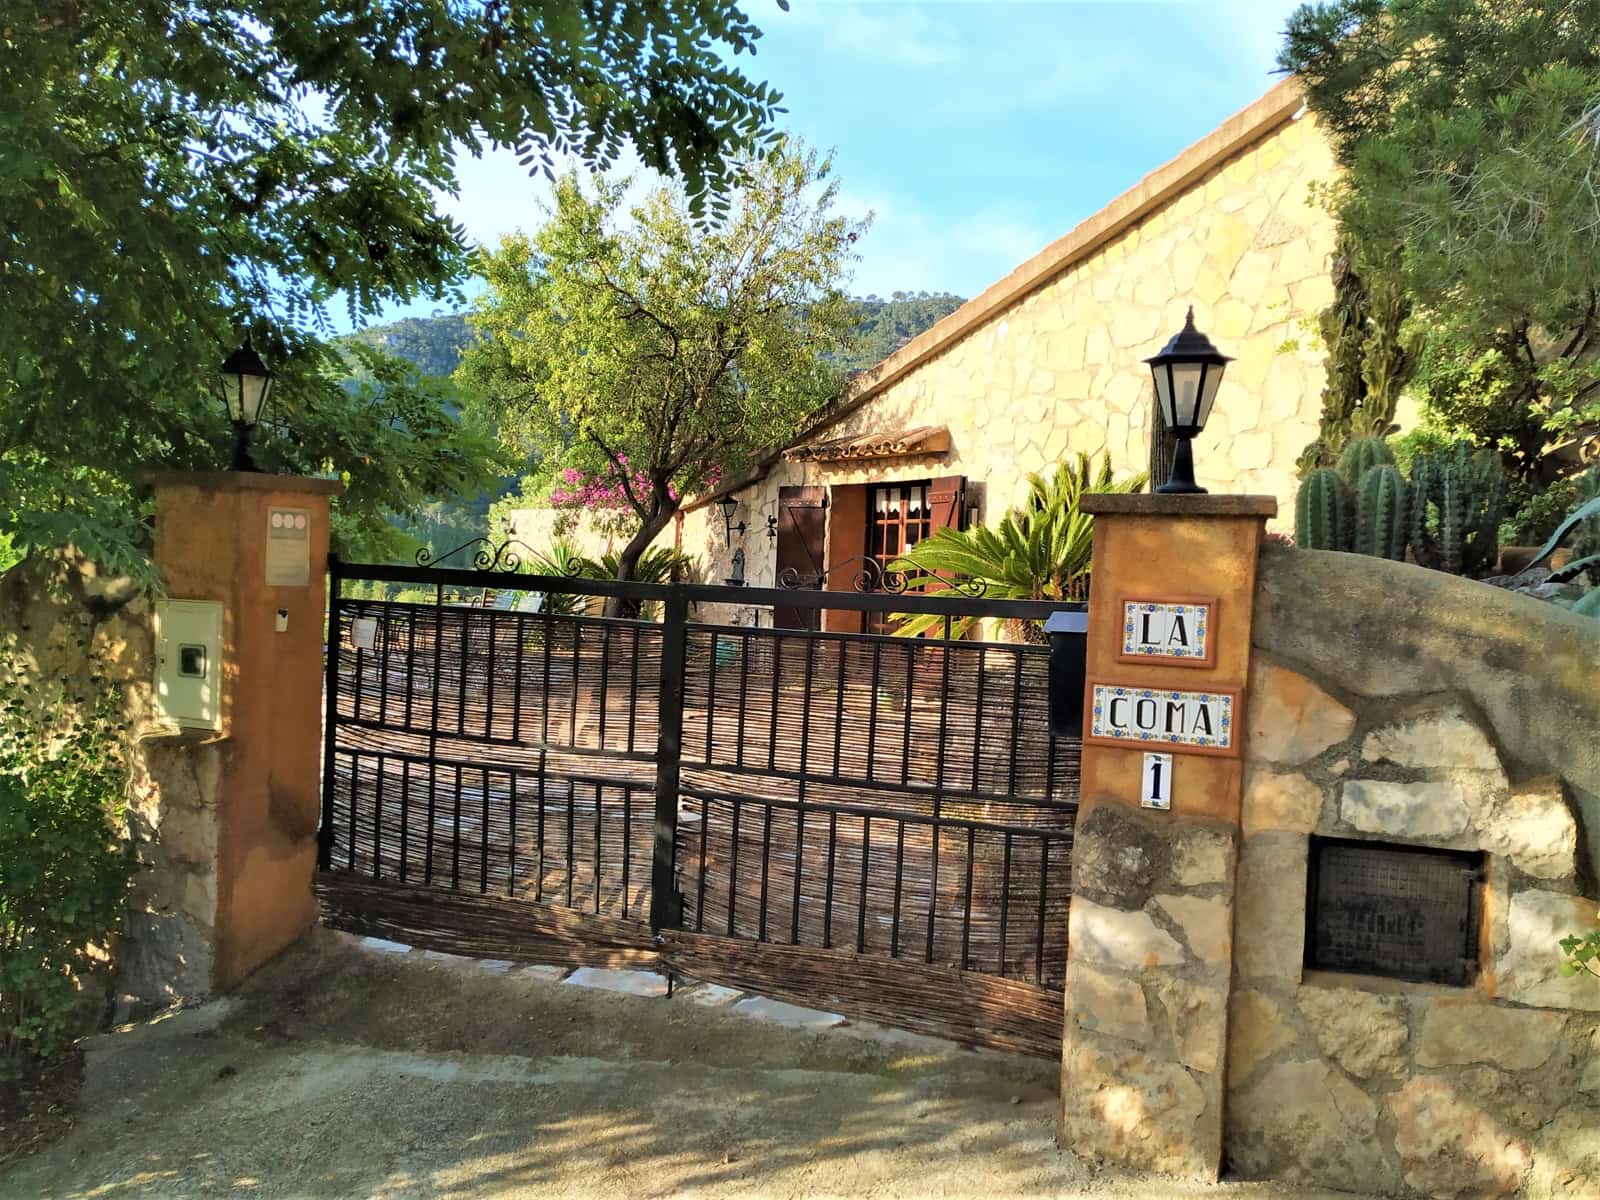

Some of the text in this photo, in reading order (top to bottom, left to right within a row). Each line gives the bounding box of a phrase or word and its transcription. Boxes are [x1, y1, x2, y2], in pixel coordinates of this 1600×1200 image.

[1140, 613, 1189, 646] LA
[1109, 697, 1213, 735] COMA
[1150, 763, 1163, 800] 1
